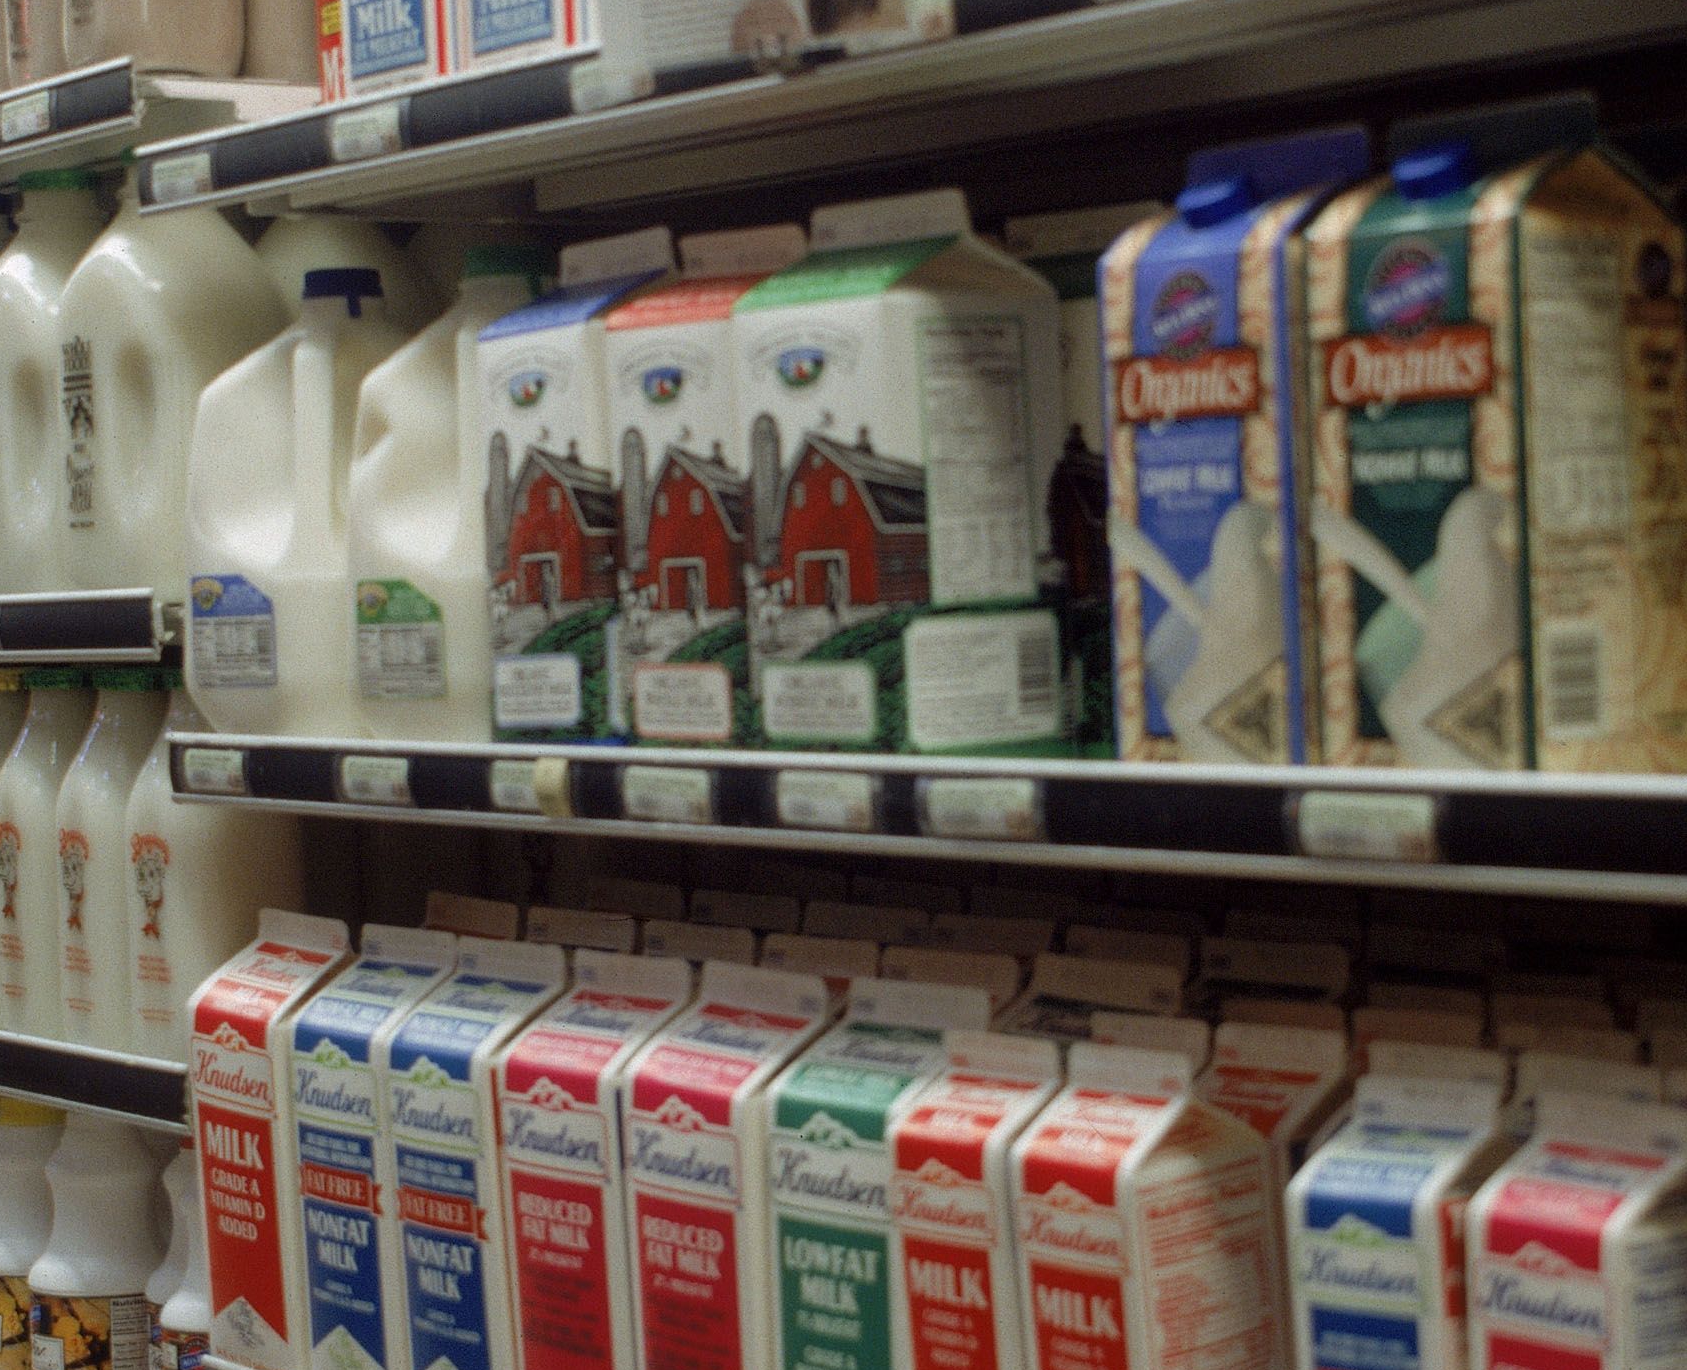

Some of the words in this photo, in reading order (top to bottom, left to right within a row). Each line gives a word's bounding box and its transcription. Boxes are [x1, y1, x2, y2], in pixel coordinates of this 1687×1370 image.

[355, 2, 414, 39] Milk
[1119, 357, 1258, 436] Organics
[1328, 336, 1487, 422] Organics
[196, 1047, 273, 1108] Knudsen
[296, 1065, 373, 1118] Knudsen
[392, 1084, 475, 1139] Knudsen
[205, 1120, 265, 1171] MILK
[508, 1106, 607, 1170] Knudsen
[211, 1167, 248, 1194] GRADE
[249, 1178, 262, 1197] A
[632, 1128, 738, 1193] Knudsen
[773, 1148, 888, 1208] Knudsen
[306, 1170, 330, 1197] FAT
[331, 1176, 364, 1202] FREE
[217, 1214, 258, 1242] ADDED
[253, 1200, 266, 1222] D
[309, 1206, 370, 1247] NONFAT
[405, 1192, 429, 1220] FAT
[431, 1198, 469, 1226] FREE
[517, 1190, 594, 1228] REDUCED
[893, 1186, 990, 1232] Knudsen
[316, 1239, 360, 1273] MILK
[408, 1230, 475, 1276] NONFAT
[548, 1224, 592, 1254] MILK
[641, 1213, 726, 1255] REDUCED
[417, 1265, 462, 1302] MILK
[675, 1246, 723, 1282] MILK
[908, 1256, 990, 1310] MILK
[800, 1275, 861, 1315] MILK
[1035, 1284, 1122, 1342] MILK
[1484, 1270, 1607, 1334] Knudsen
